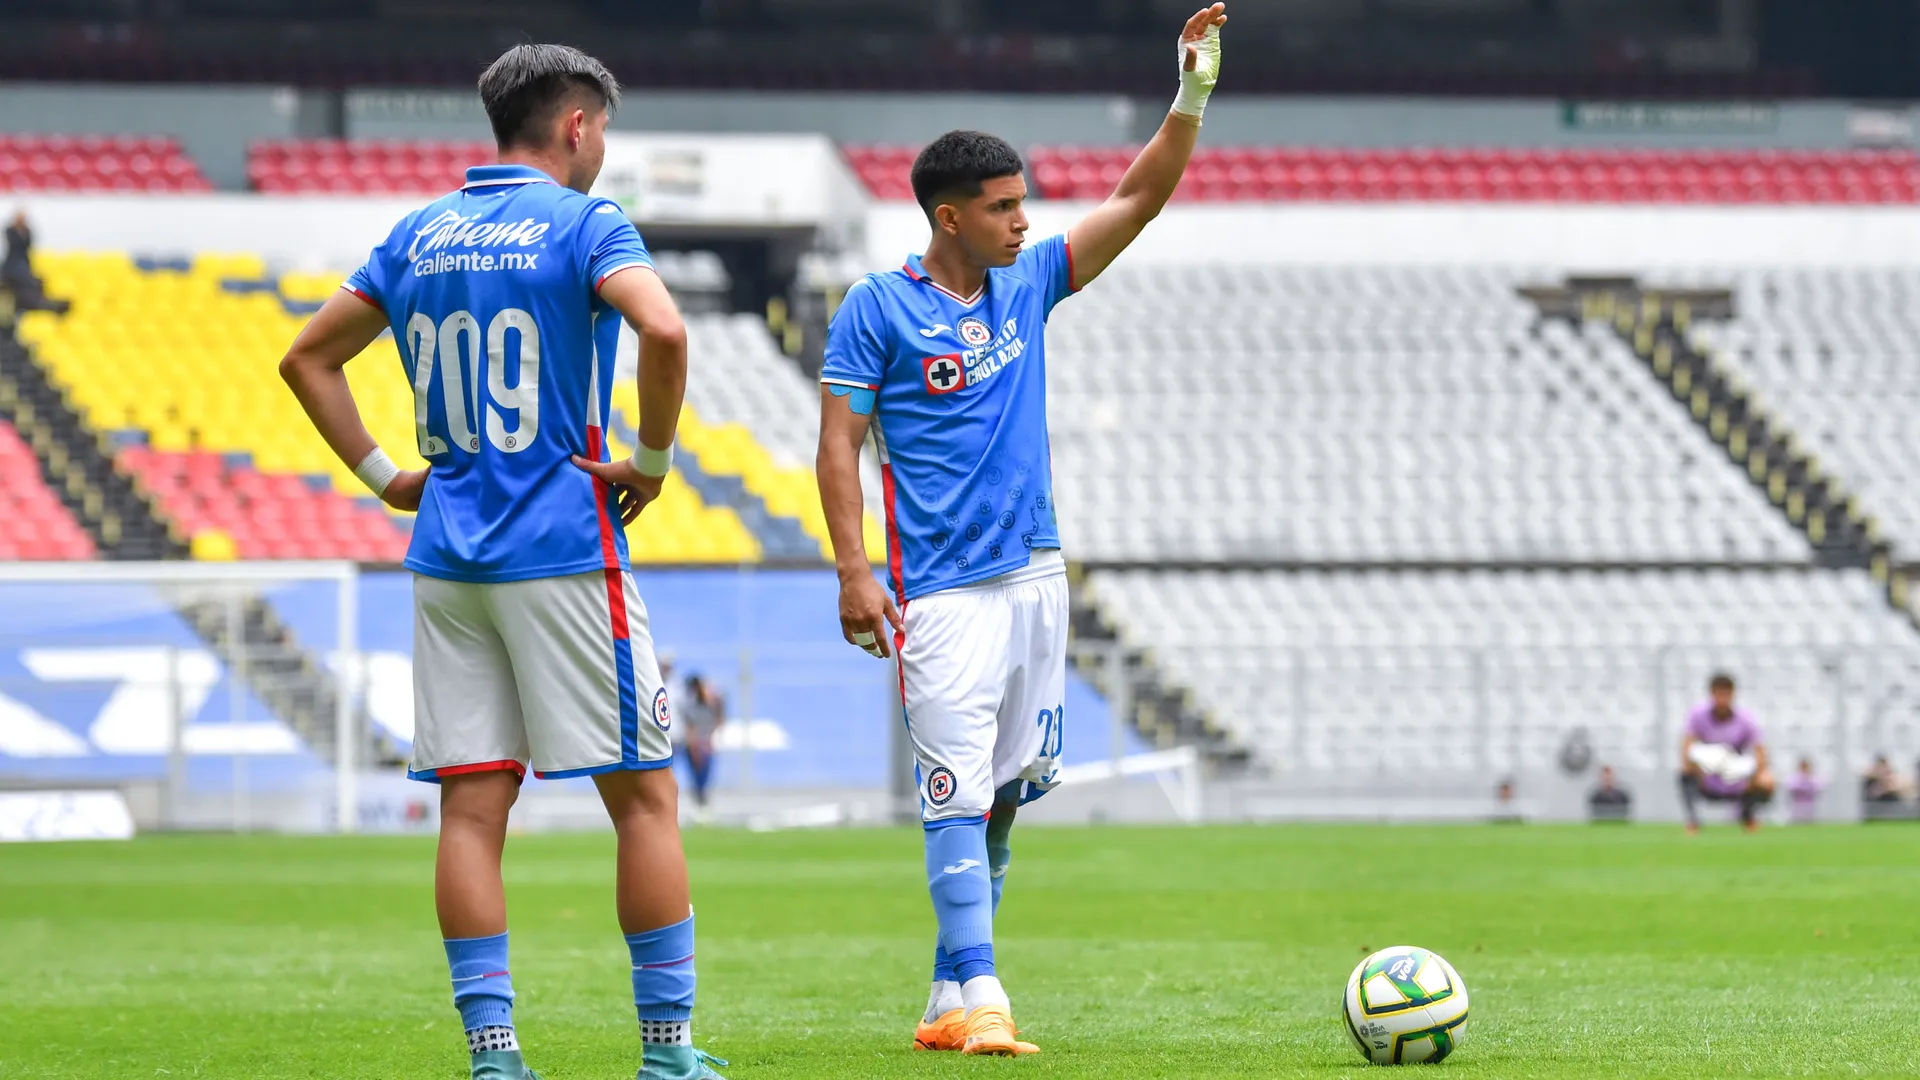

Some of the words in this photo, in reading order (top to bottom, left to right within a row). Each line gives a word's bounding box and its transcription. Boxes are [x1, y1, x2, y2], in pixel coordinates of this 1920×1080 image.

[408, 209, 550, 262] Caliente
[414, 251, 539, 277] caliente.mx
[406, 308, 540, 456] 209
[966, 356, 1001, 387] CRUZ
[996, 337, 1025, 367] AZUL
